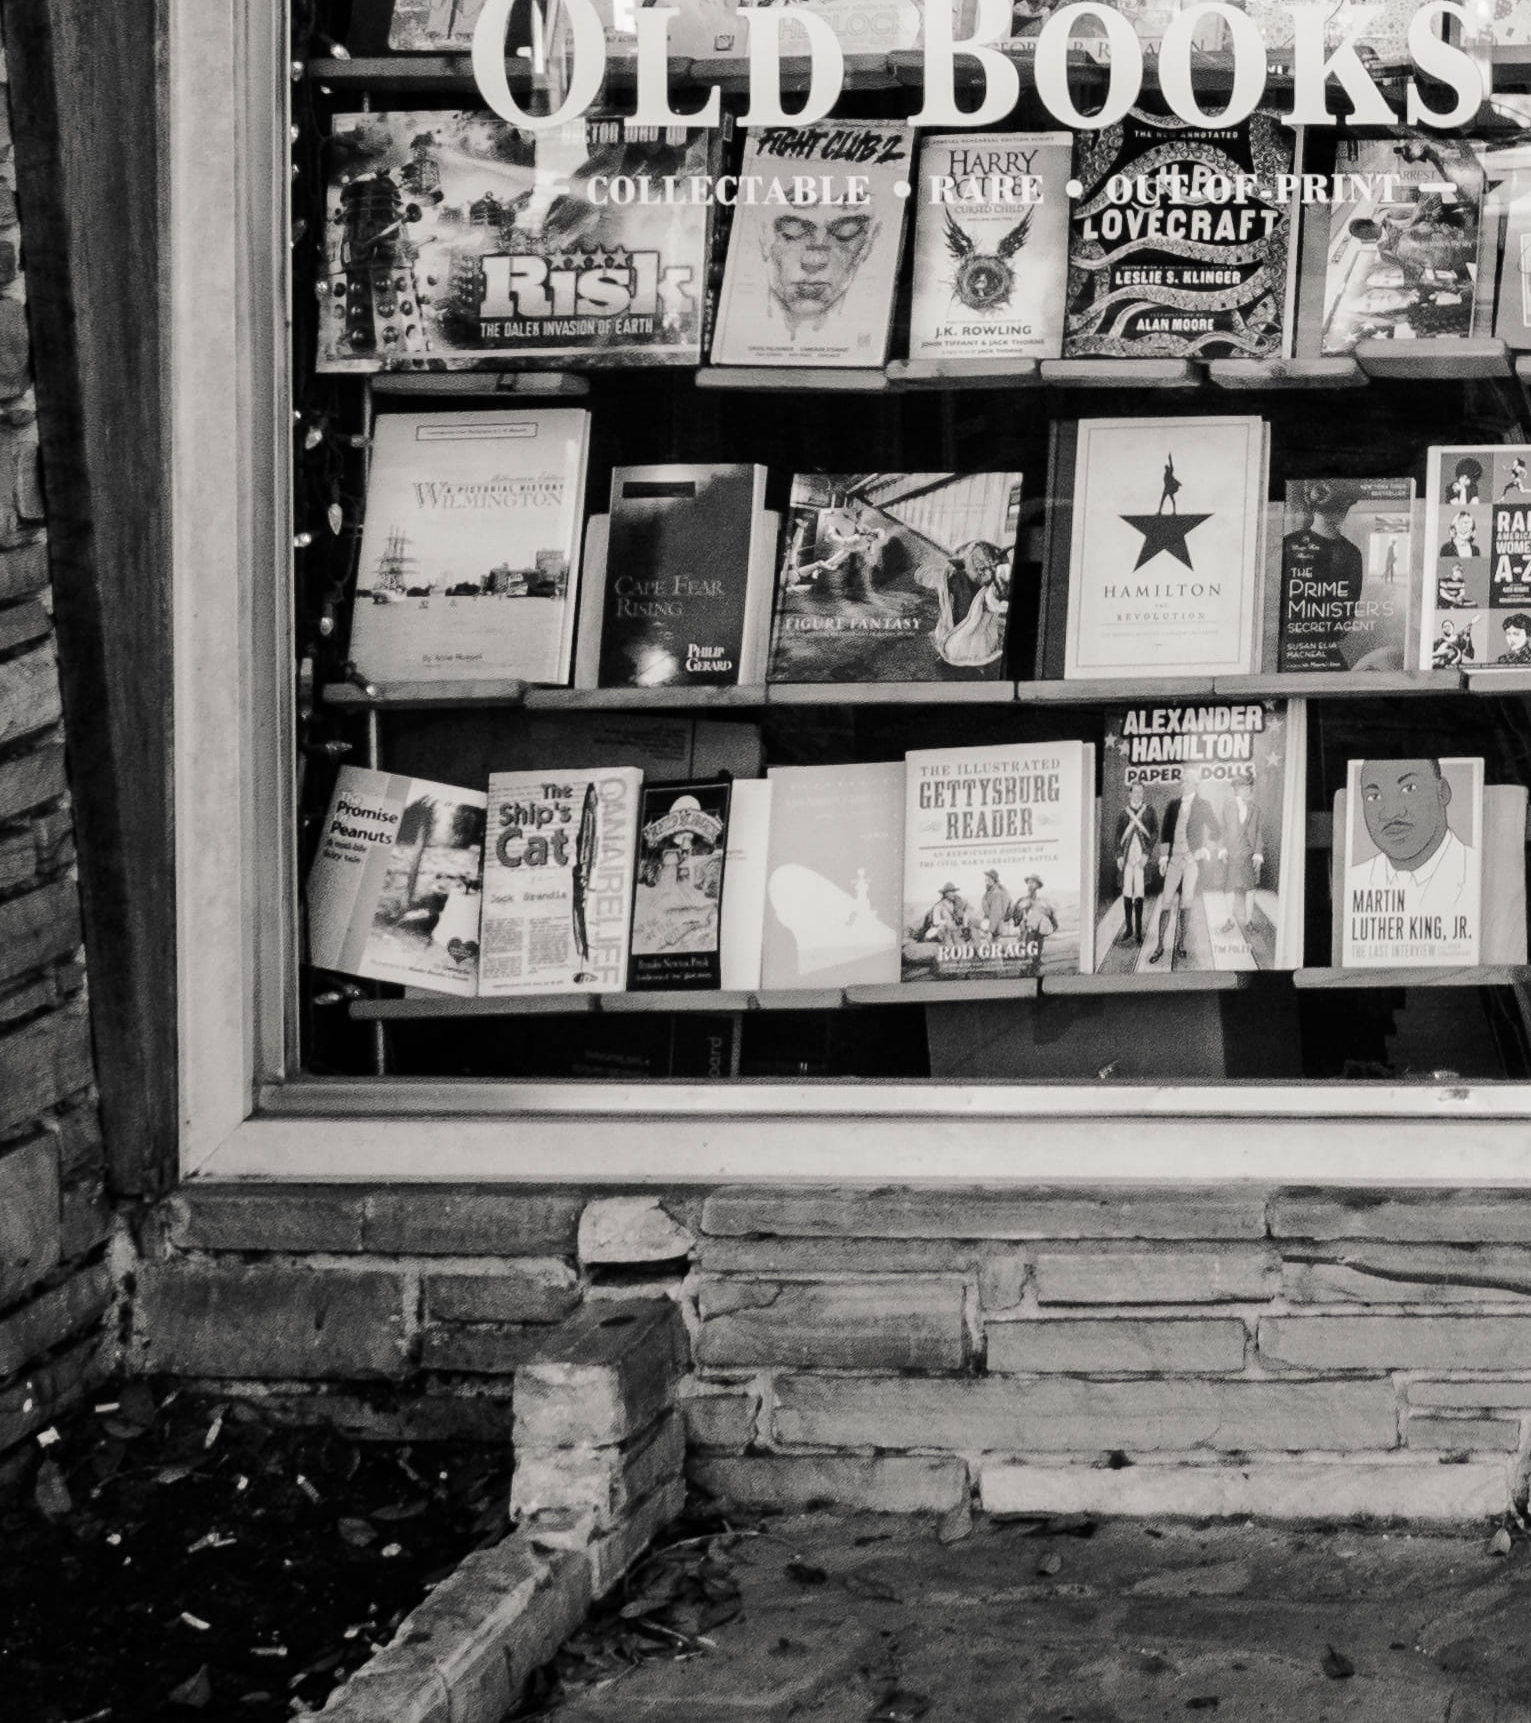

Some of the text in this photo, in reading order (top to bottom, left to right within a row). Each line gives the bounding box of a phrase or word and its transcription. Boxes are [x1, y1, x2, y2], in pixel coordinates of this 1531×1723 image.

[756, 127, 905, 164] FIGHT CLUB 2
[950, 149, 1038, 176] HARRY
[585, 172, 1402, 207] COLLECTABLE RARE OUT-OF-PRINT
[1082, 209, 1278, 241] LOVECRAFT
[479, 248, 694, 319] Risk
[1136, 319, 1214, 331] ALAN MOORE
[1103, 582, 1222, 599] HAMILTON
[1289, 579, 1349, 599] PRIME
[1123, 705, 1264, 736] ALEXANDER
[1130, 733, 1251, 763] HAMILTON
[1126, 764, 1256, 784] PAPER DOLLS
[540, 783, 574, 799] The
[919, 774, 1060, 809] GETTYSBURG
[498, 802, 572, 829] Ship's
[945, 808, 1034, 840] READER
[496, 827, 570, 868] Cat
[1352, 889, 1406, 913] MARTIN
[1352, 916, 1473, 942] LUTHER KING, JR.
